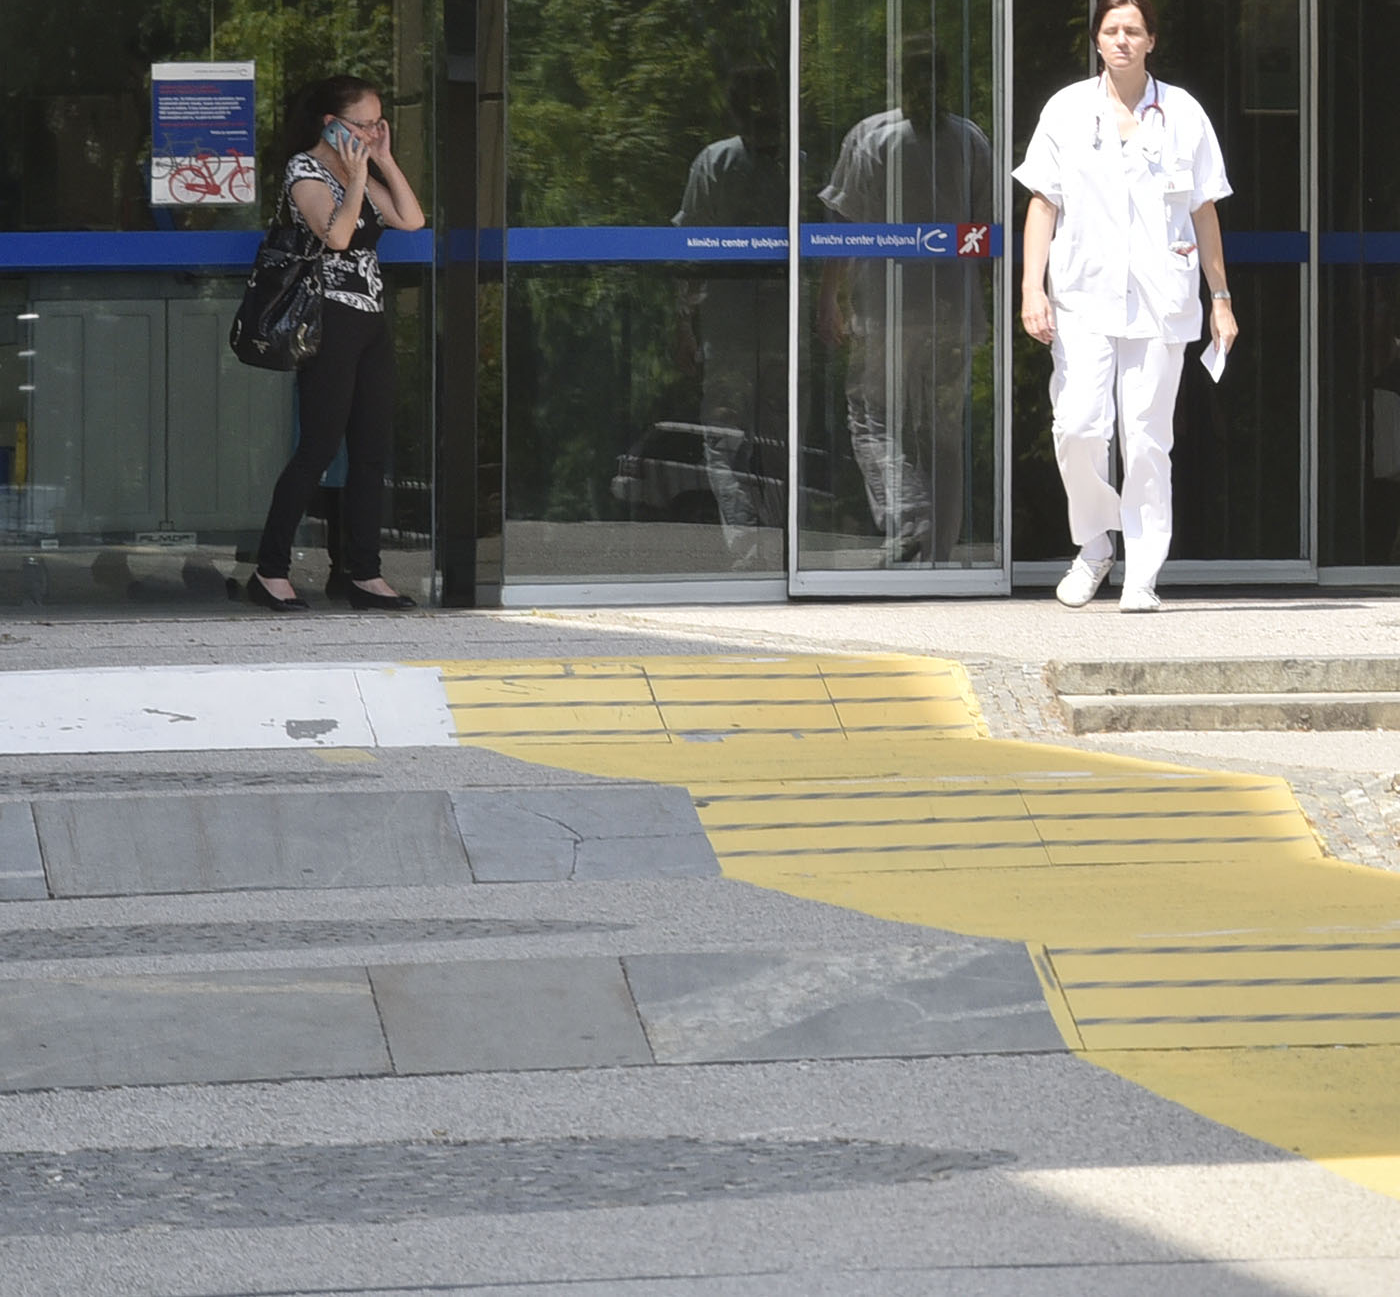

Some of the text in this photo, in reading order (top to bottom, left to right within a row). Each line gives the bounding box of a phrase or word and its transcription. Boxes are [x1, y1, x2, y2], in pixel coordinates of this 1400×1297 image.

[687, 237, 719, 247] klinični
[721, 238, 749, 248] center
[810, 234, 916, 247] klinični center ljubljana
